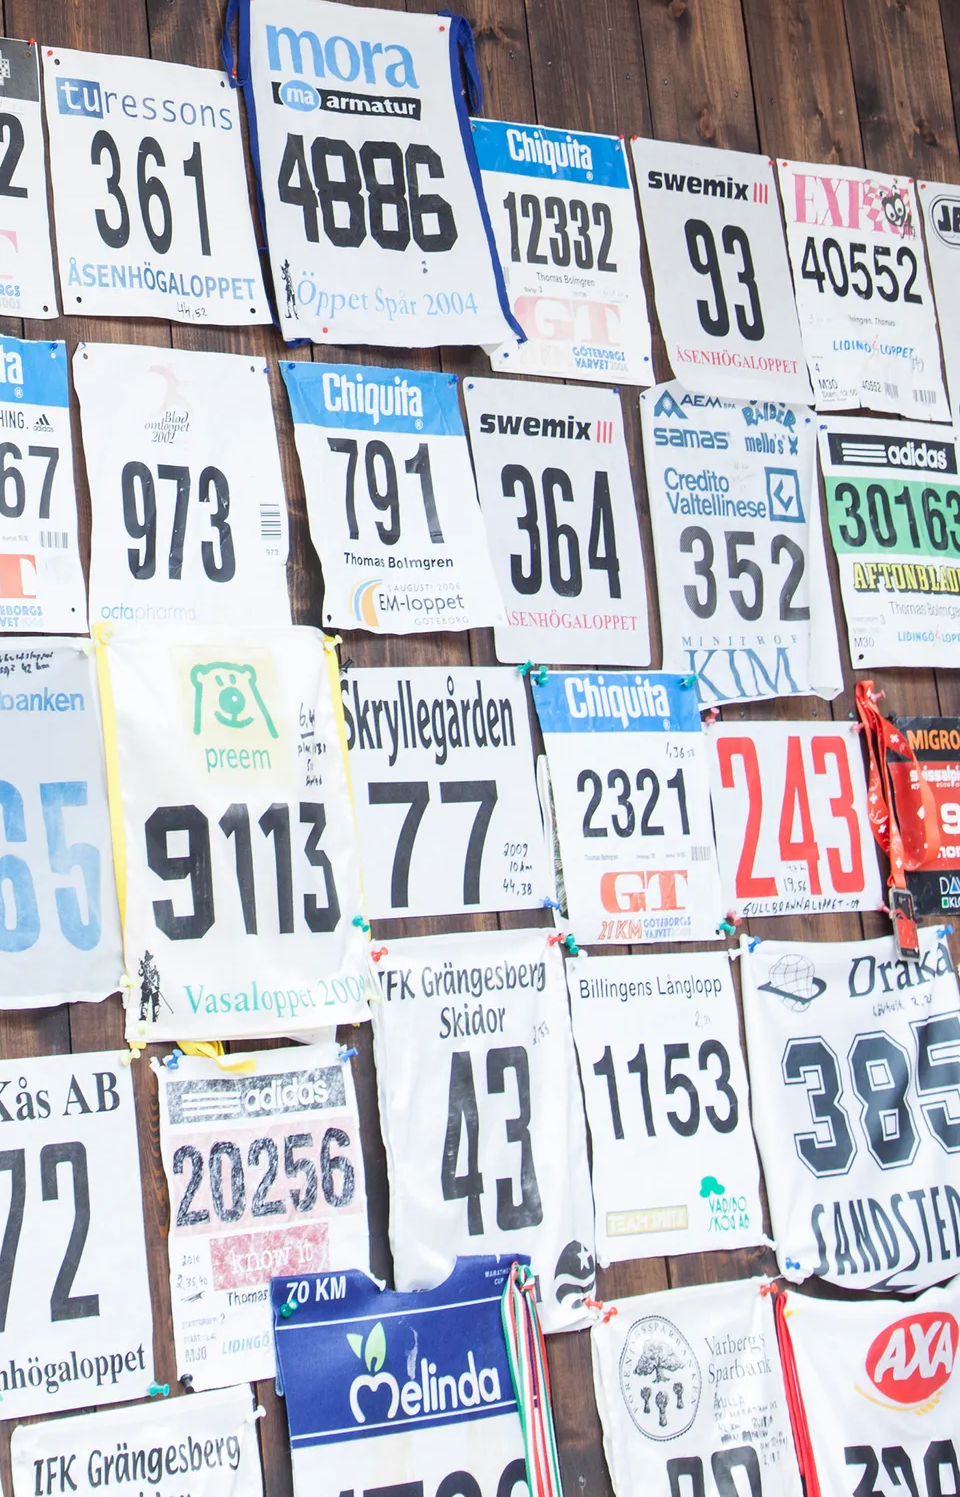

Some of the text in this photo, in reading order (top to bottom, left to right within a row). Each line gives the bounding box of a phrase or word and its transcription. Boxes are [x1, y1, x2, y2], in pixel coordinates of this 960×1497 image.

[266, 24, 420, 90] mora
[61, 82, 234, 130] turessons
[285, 88, 417, 117] ma armatur
[507, 128, 592, 175] Chiquita
[90, 130, 212, 256] 361
[278, 133, 459, 253] 4886
[648, 170, 749, 201] swemix
[503, 191, 618, 273] 12332
[67, 257, 256, 300] ÅSENHÖGALOPPET
[684, 219, 766, 342] 93
[801, 235, 924, 305] 40552
[297, 271, 479, 321] Öppet Spår 2004
[676, 346, 799, 375] ÅSENHÖGALOPPET
[322, 372, 424, 425] Chiquita
[680, 394, 723, 409] AEM
[818, 379, 882, 393] M30 40552
[479, 413, 592, 441] swemix
[653, 427, 729, 450] samas
[887, 441, 948, 470] adidas
[327, 437, 446, 546] 791
[664, 467, 730, 493] Credito
[121, 460, 237, 583] 973
[665, 492, 767, 518] Valtellinese
[834, 482, 960, 553] 30163
[501, 463, 621, 600] 364
[343, 552, 454, 571] Thomas Bolmgren
[679, 526, 811, 622] 352
[100, 603, 196, 622] octapharma
[379, 593, 465, 615] EM-loppet
[683, 647, 806, 704] KIM
[340, 674, 517, 767] Skryllegården
[564, 675, 671, 729] Chiquita
[205, 747, 271, 772] preem
[577, 768, 691, 838] 2321
[716, 735, 866, 899] 243
[368, 779, 499, 908] 77
[144, 802, 341, 941] 9113
[600, 869, 689, 914] GT
[615, 919, 643, 940] KM
[183, 981, 317, 1019] Vasaloppet
[421, 960, 546, 998] Grängesberg
[579, 974, 723, 1004] Billingens Långlopp
[439, 1003, 506, 1039] Skidor
[62, 1072, 121, 1117] AB
[243, 1078, 328, 1114] adidas
[592, 1039, 739, 1140] 1153
[780, 1009, 960, 1179] 385
[440, 1045, 543, 1236] 43
[172, 1127, 356, 1228] 20256
[227, 1289, 269, 1306] Thomas
[286, 1276, 347, 1304] 70 KM
[704, 1333, 766, 1357] Varbergs
[873, 1320, 953, 1383] AXA
[349, 1350, 502, 1424] Melinda
[707, 1357, 773, 1388] Sparbank
[33, 1435, 242, 1496] IFK Grängesberg
